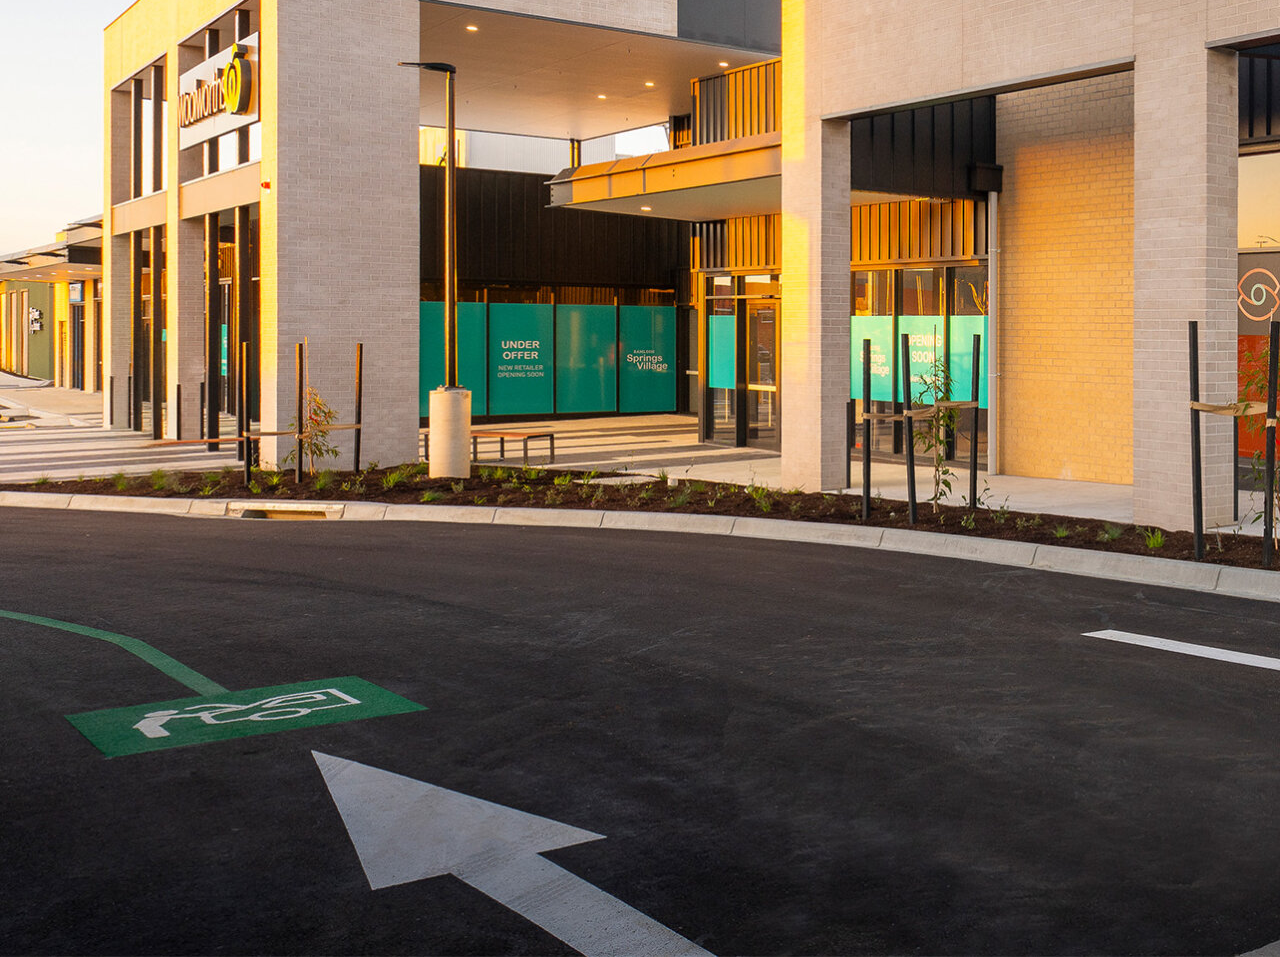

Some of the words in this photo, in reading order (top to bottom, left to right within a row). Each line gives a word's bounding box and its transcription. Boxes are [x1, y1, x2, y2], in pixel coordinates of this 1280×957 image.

[501, 340, 540, 349] UNDER
[502, 351, 539, 360] OFFER
[626, 353, 663, 364] Springs
[636, 362, 668, 372] Village
